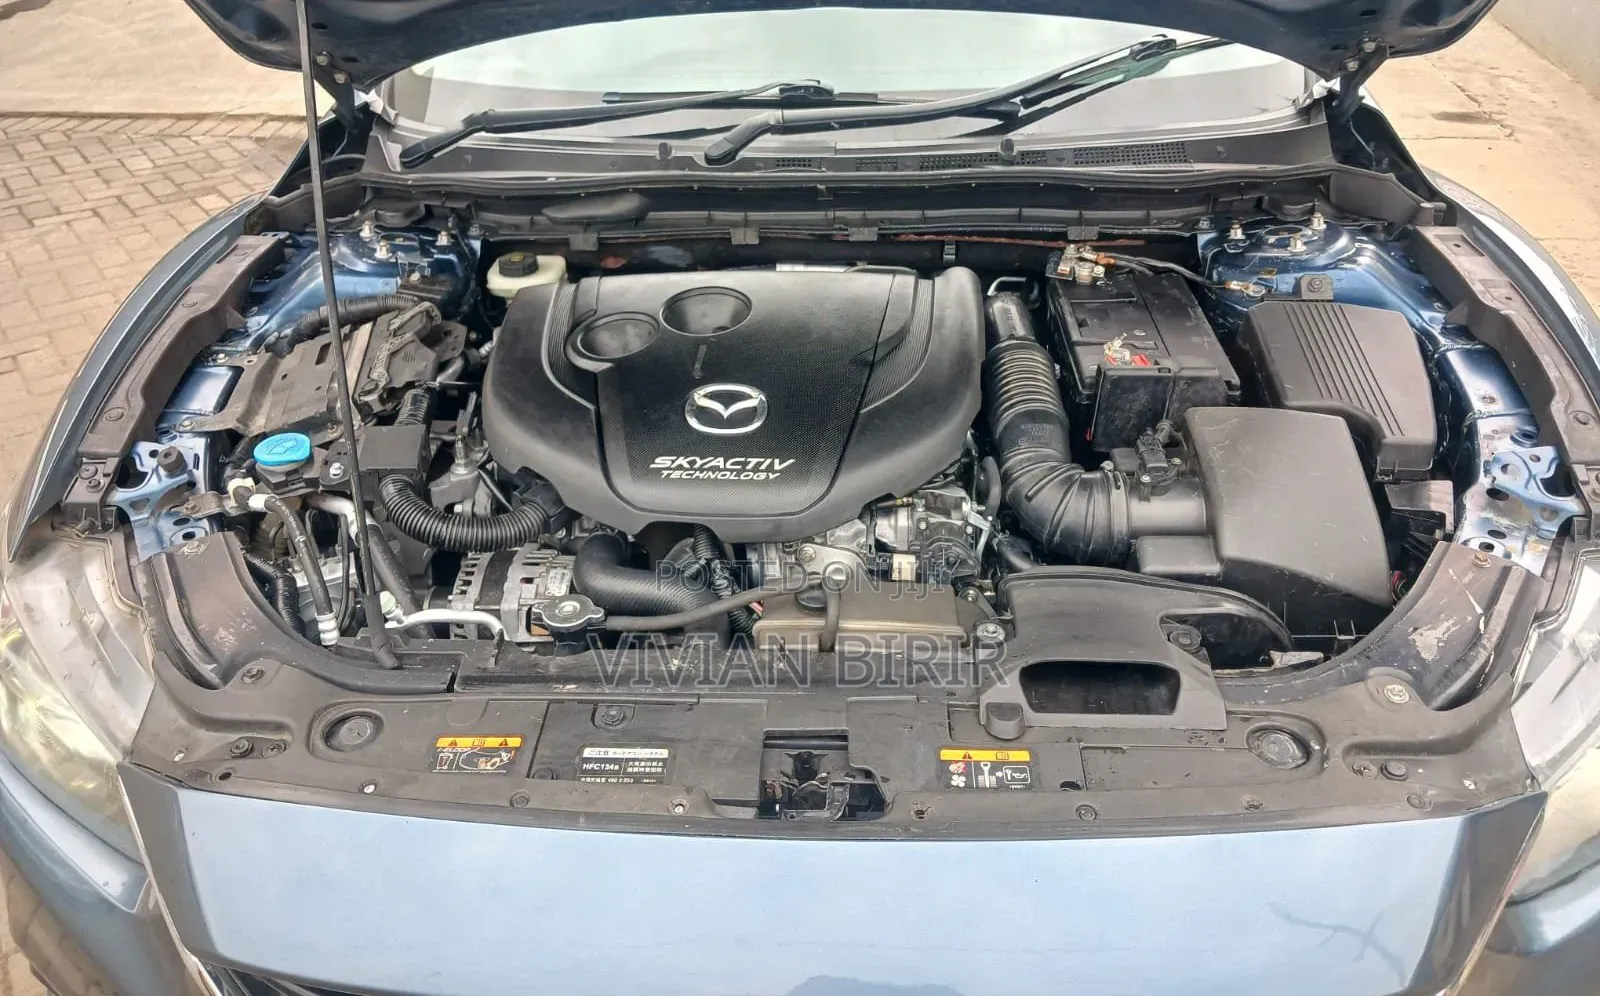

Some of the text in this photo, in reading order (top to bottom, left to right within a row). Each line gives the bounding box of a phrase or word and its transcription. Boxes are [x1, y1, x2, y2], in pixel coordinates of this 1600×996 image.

[649, 456, 796, 471] SKYACTIV
[661, 470, 781, 480] TECHNOLOGY
[582, 763, 620, 771] HFC134a
